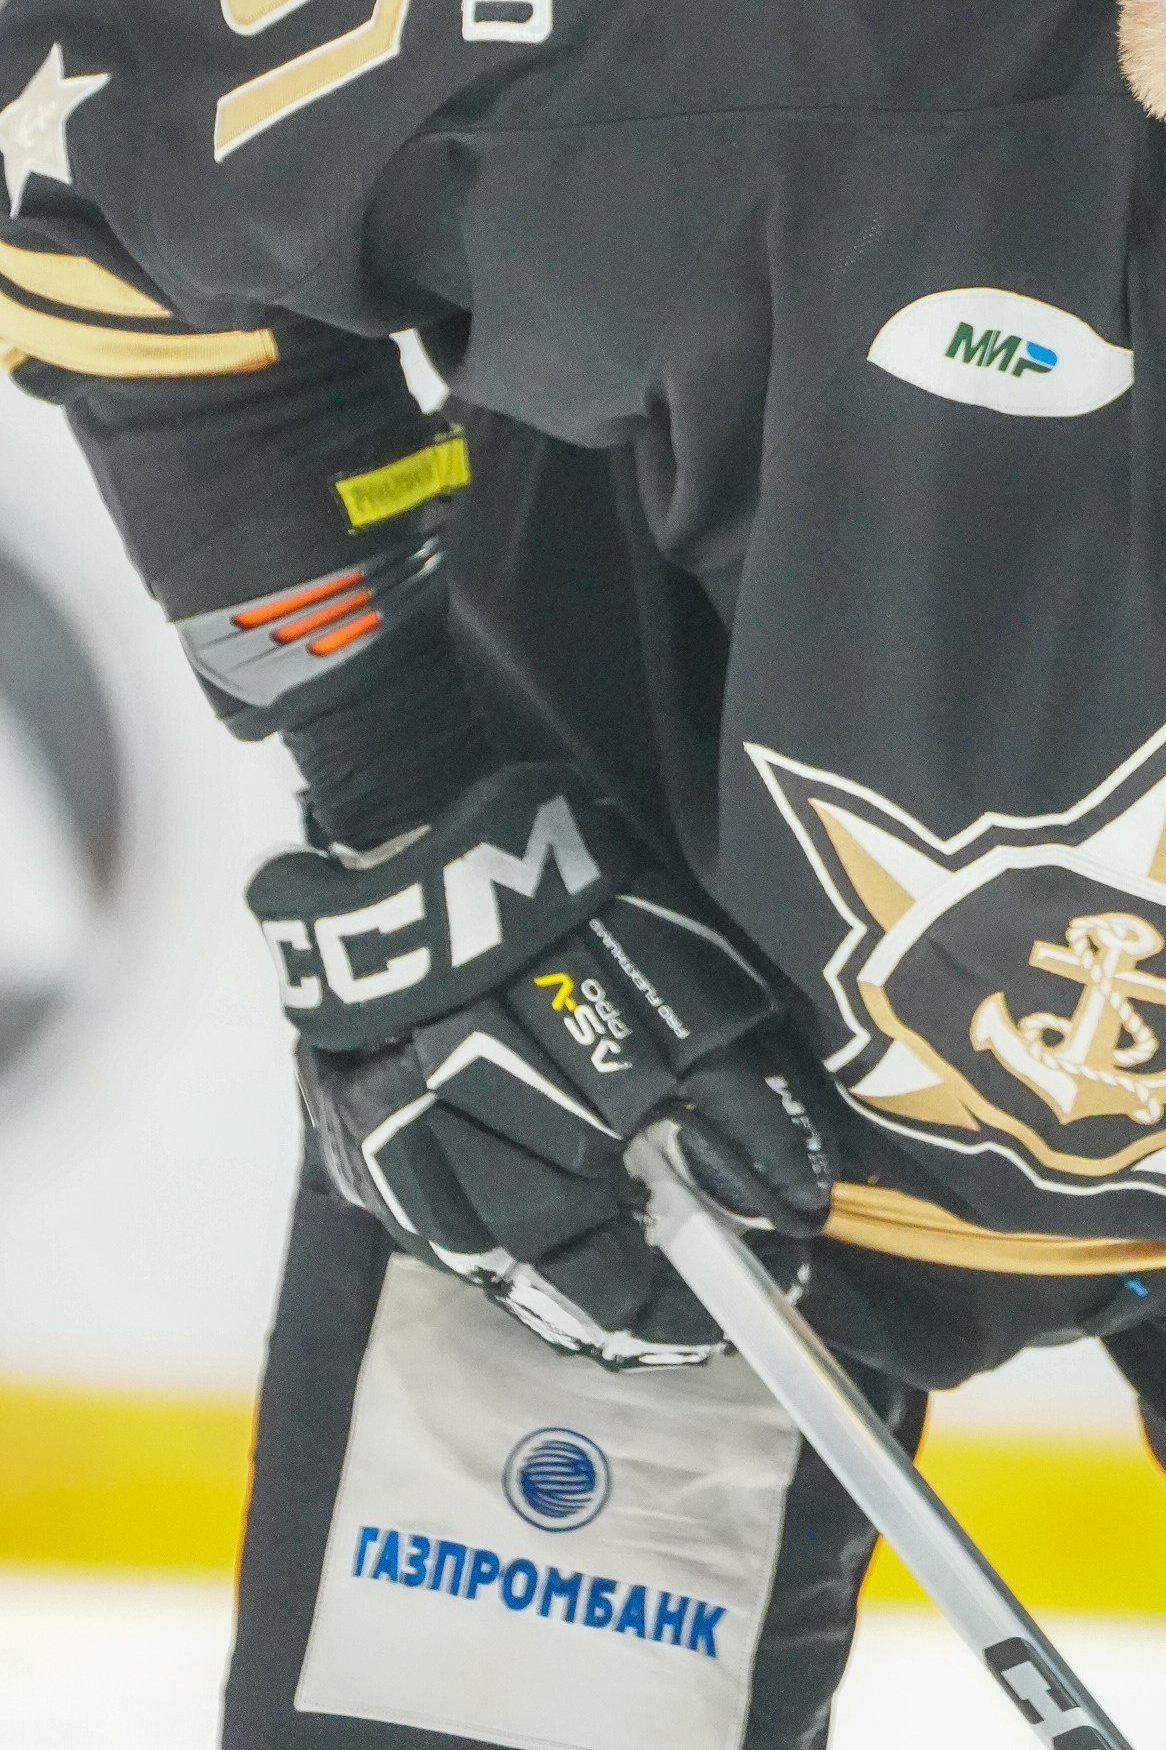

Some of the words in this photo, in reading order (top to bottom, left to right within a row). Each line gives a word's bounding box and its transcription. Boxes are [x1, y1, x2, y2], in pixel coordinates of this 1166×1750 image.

[944, 321, 1058, 378] МИР
[260, 795, 602, 1010] CCM
[580, 978, 633, 1040] PRO
[351, 1525, 730, 1659] ГАЗПРОМБАНК
